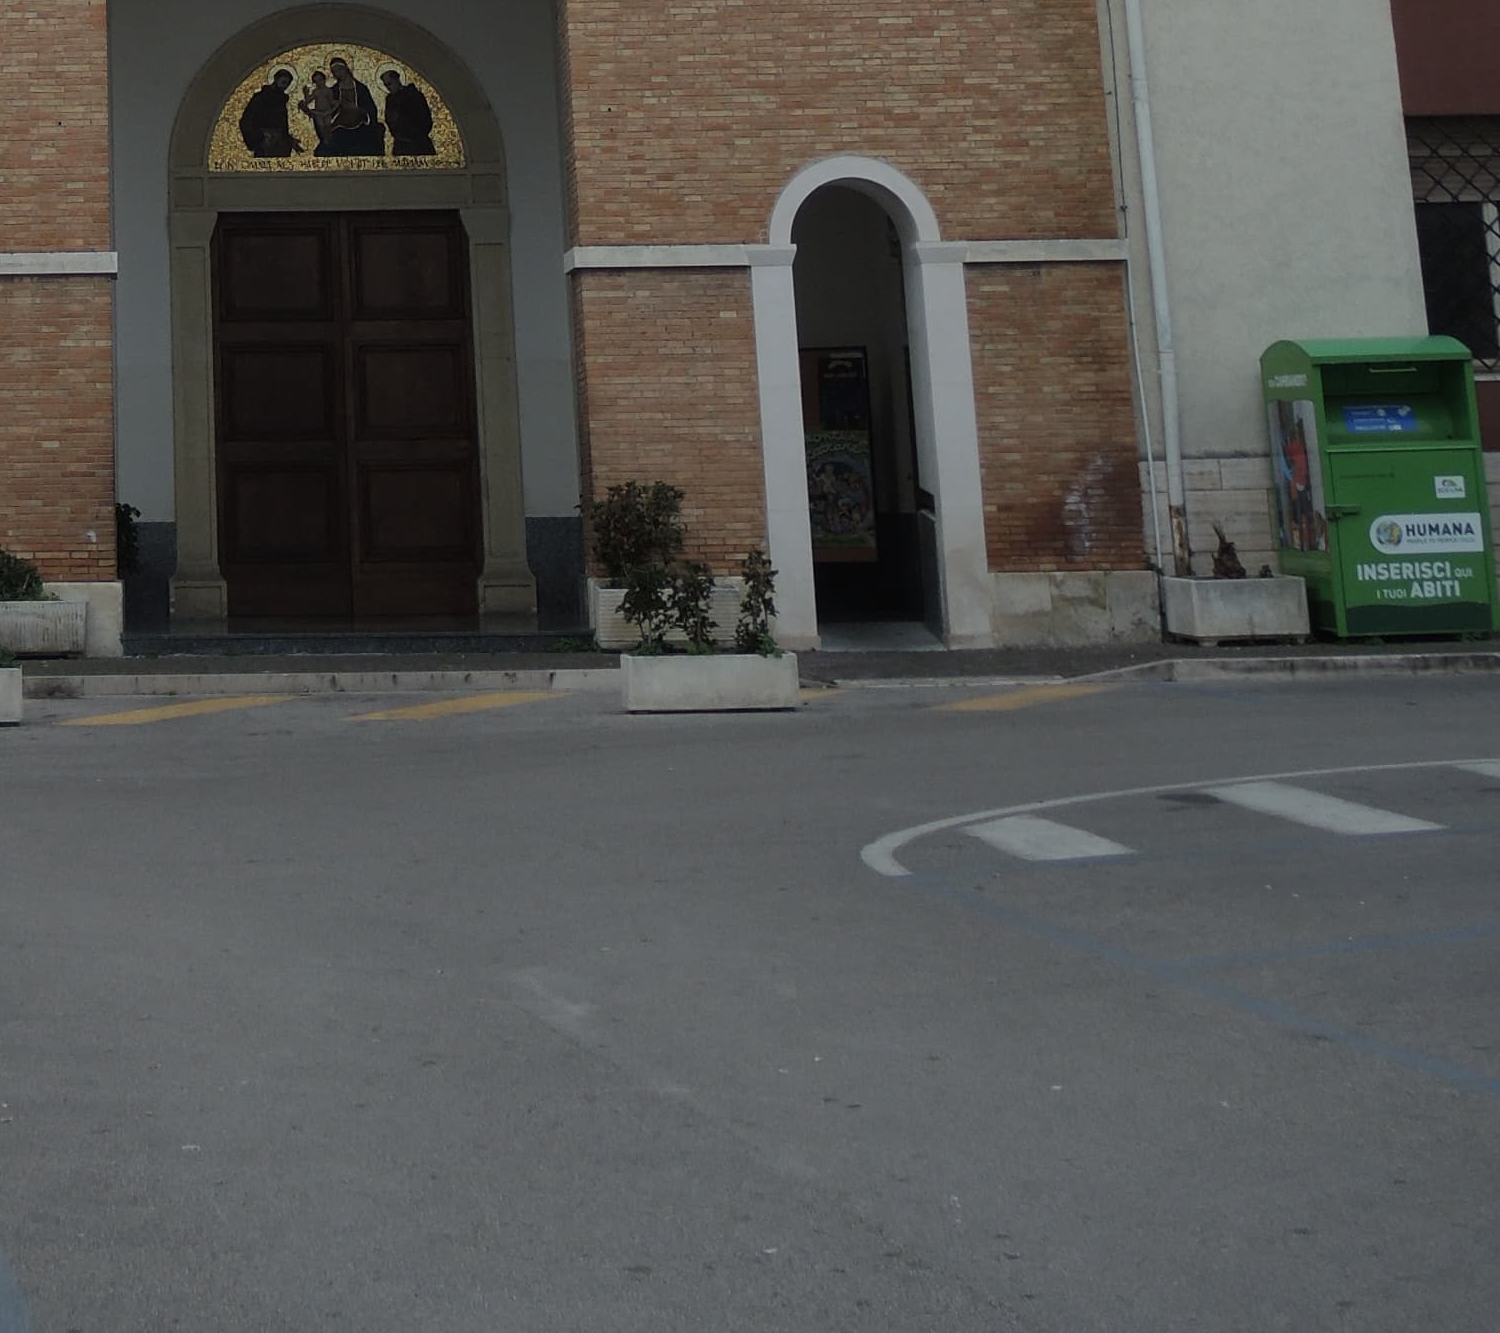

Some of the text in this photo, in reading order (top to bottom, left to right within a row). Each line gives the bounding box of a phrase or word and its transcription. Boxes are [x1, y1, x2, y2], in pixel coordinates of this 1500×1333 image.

[1405, 522, 1476, 537] HUMANA
[1356, 561, 1473, 581] INSERISCI QUI
[1410, 580, 1461, 598] ABITI
